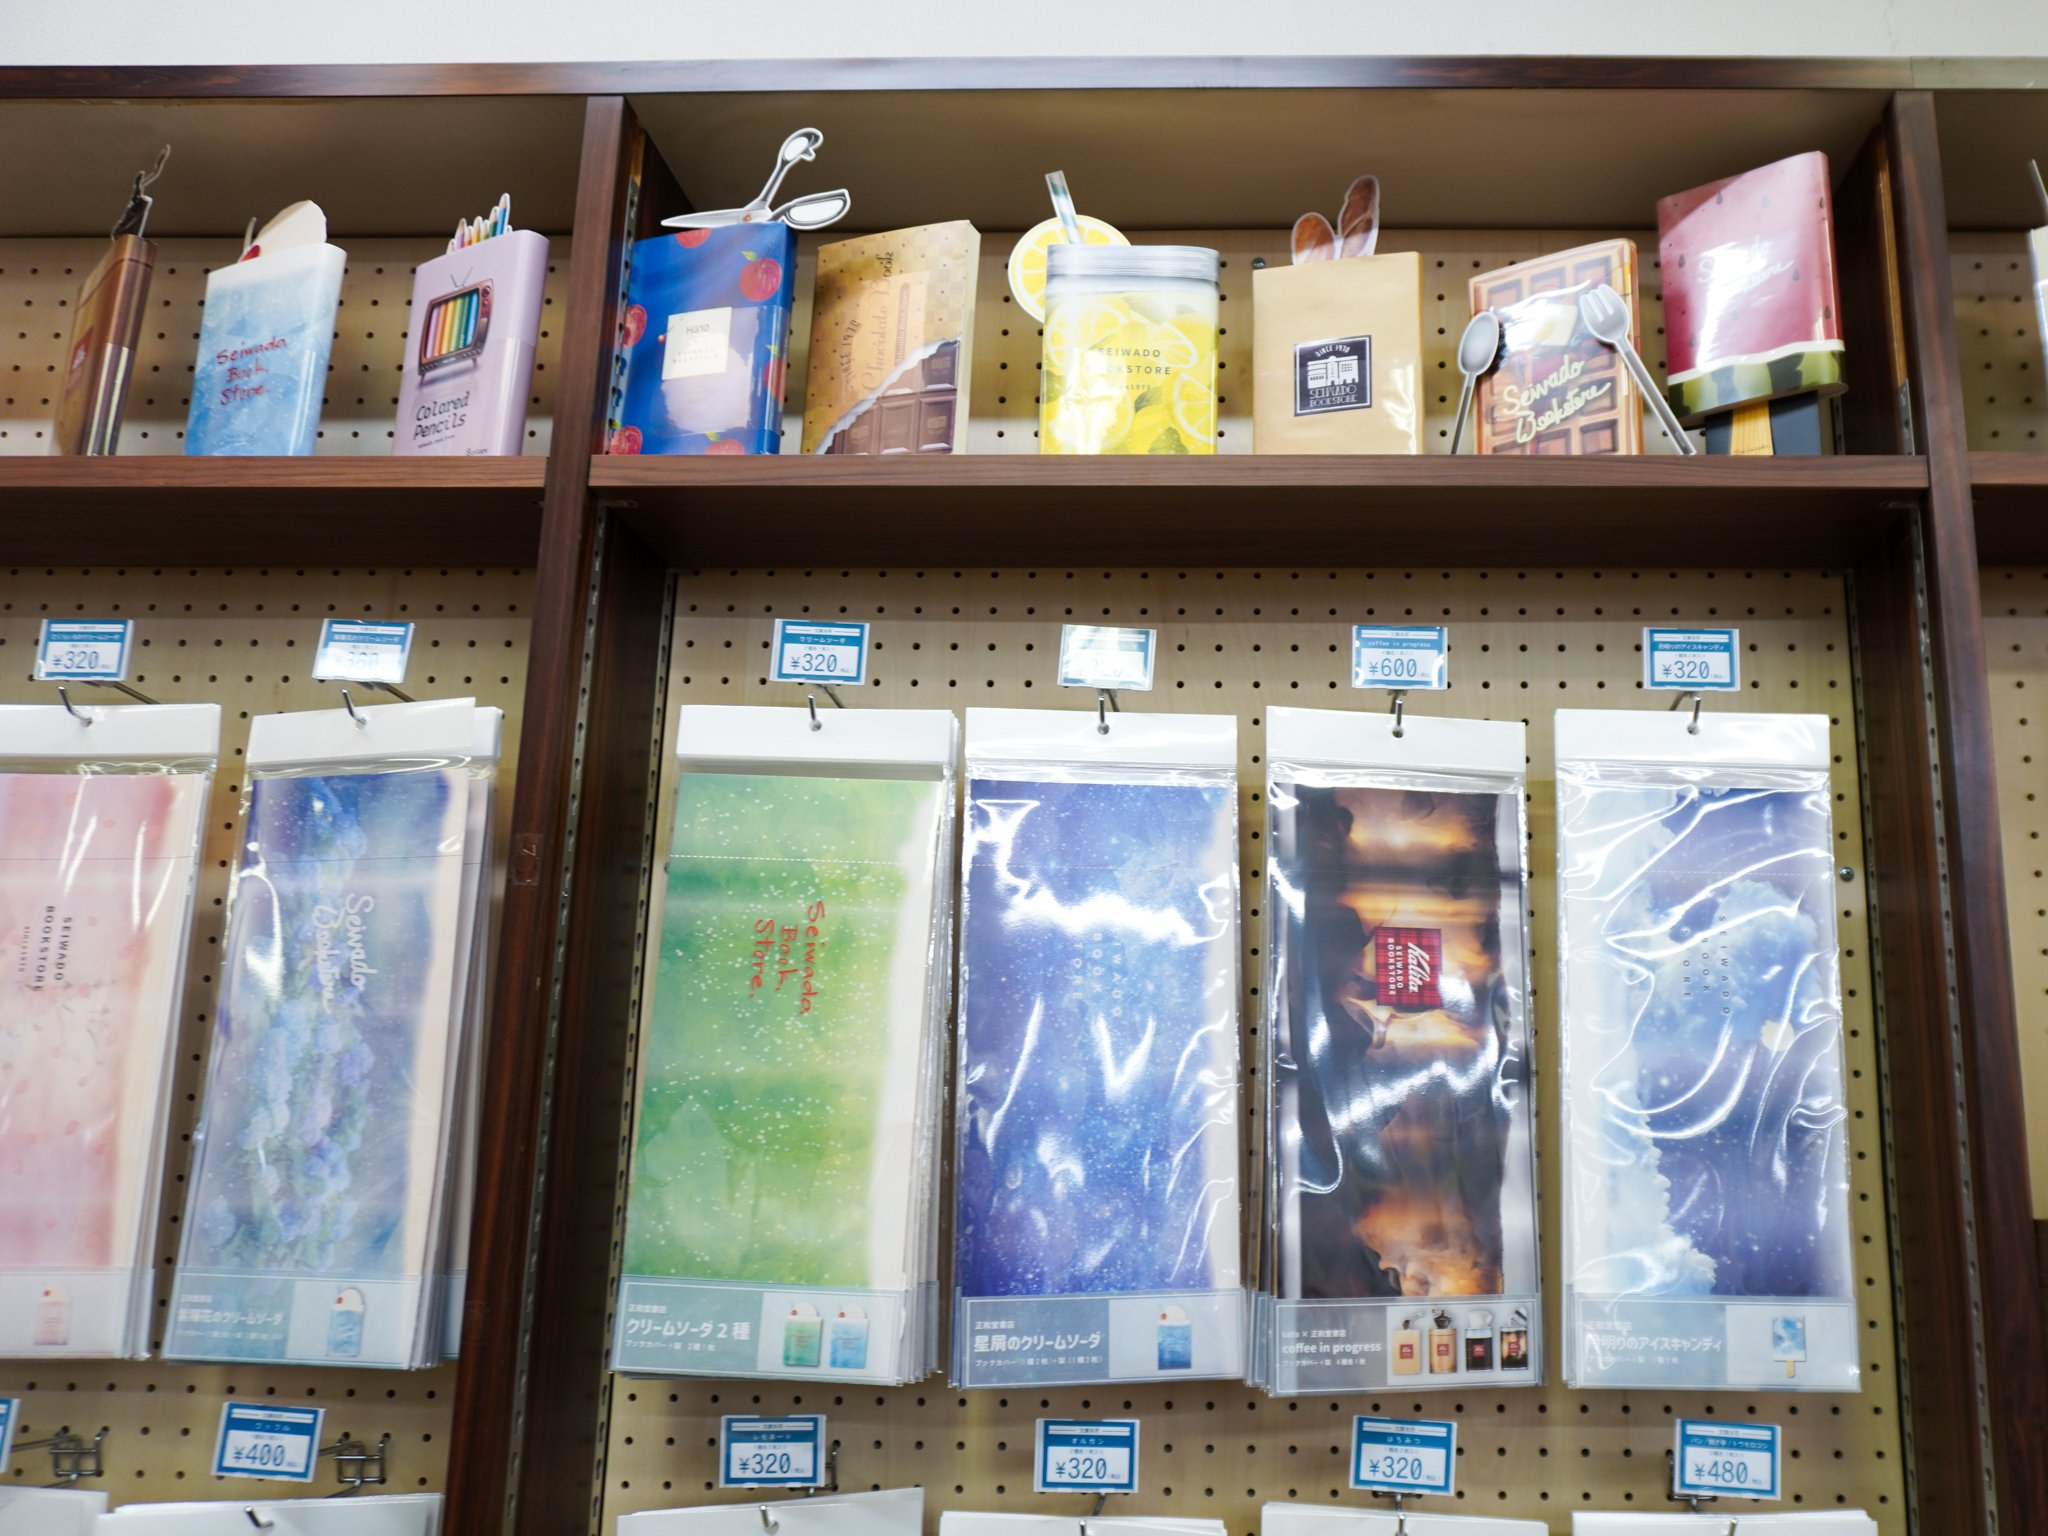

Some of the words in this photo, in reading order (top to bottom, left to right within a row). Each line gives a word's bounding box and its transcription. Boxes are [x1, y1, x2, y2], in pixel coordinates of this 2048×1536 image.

[1097, 348, 1161, 358] SEIWADO
[1315, 345, 1333, 357] SINCE
[1310, 385, 1357, 399] SEIWADO
[1503, 354, 1586, 415] Seiwado
[416, 390, 470, 421] Colored
[1310, 395, 1358, 408] BOOKSTORE
[413, 413, 466, 440] Pencils
[53, 650, 98, 669] ¥320
[790, 653, 837, 673] ¥320
[1369, 658, 1417, 677] ¥600
[1662, 660, 1710, 679] ¥320
[53, 916, 73, 981] SEIWADO
[1387, 937, 1396, 996] BOOKSTORE
[1395, 945, 1404, 989] SEIWADO
[1681, 930, 1692, 998] SORE
[1702, 937, 1711, 992] BOOK
[1719, 916, 1731, 1014] SEIWADO
[973, 1331, 1102, 1353] 星屑のクリームソーダ
[1282, 1343, 1317, 1354] coffee
[1319, 1342, 1330, 1353] in
[1332, 1343, 1382, 1355] progress
[233, 1443, 285, 1467] ¥400
[739, 1453, 790, 1474] ¥320
[1056, 1457, 1107, 1479] ¥320
[1369, 1456, 1422, 1480] ¥320
[1695, 1460, 1748, 1485] ¥480
